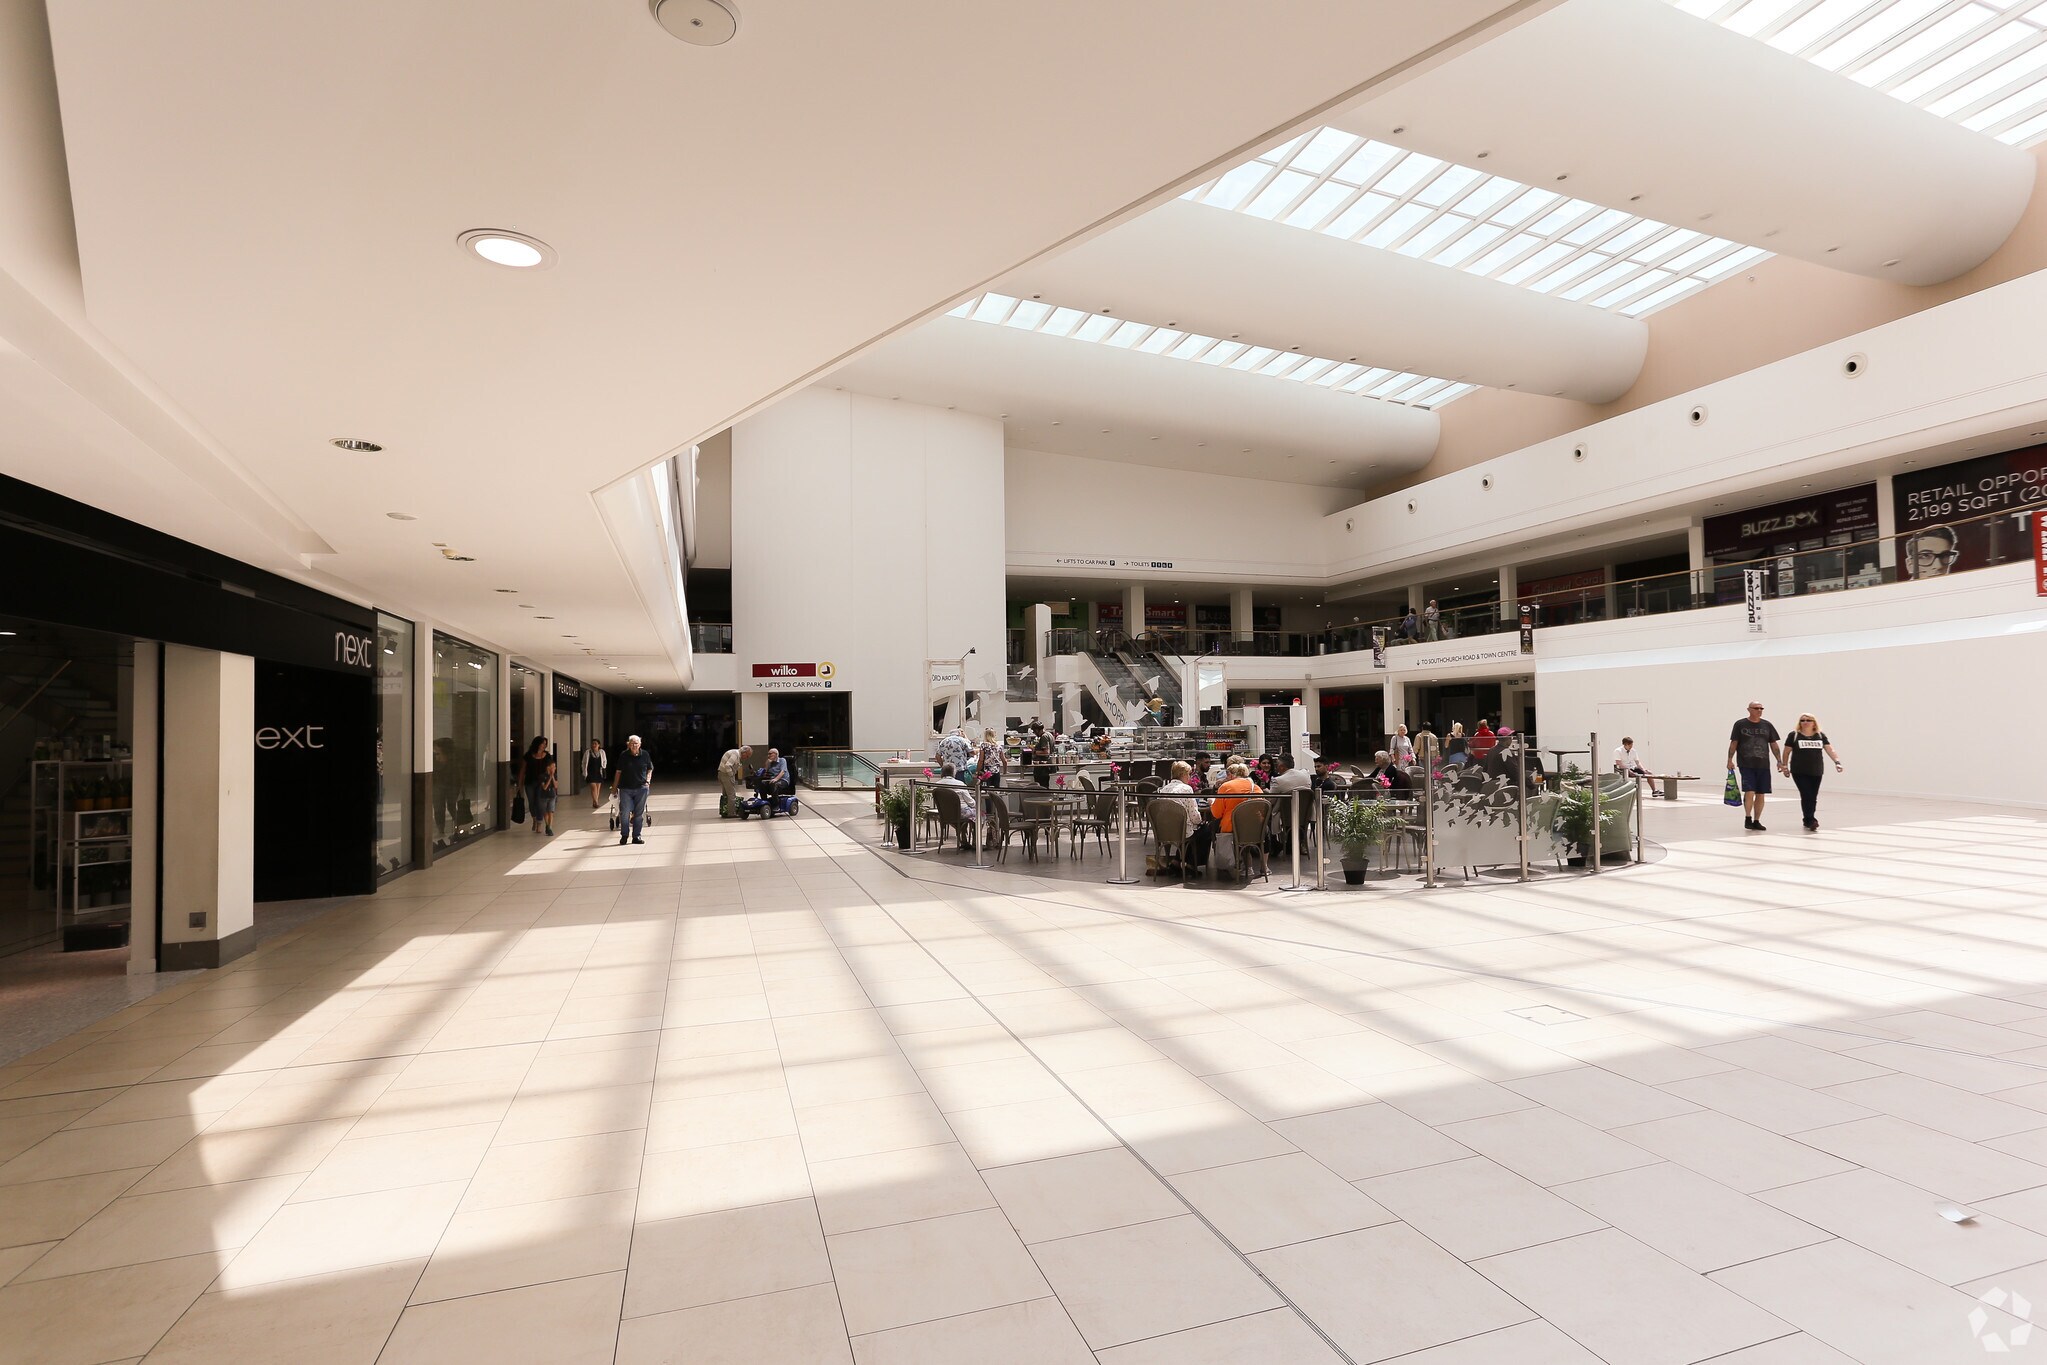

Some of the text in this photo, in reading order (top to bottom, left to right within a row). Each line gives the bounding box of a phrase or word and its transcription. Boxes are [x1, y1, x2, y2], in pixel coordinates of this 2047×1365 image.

[1908, 483, 1973, 505] RETAIL
[1909, 502, 1952, 521] 2,199
[1958, 491, 2012, 511] SQFT
[1145, 606, 1175, 617] Smart
[335, 632, 372, 668] next
[1428, 656, 1461, 664] SOUTHCHURCH
[1497, 650, 1517, 658] CENTRE
[771, 665, 798, 676] wilko
[256, 725, 324, 749] ext
[1741, 727, 1769, 737] QUEEN
